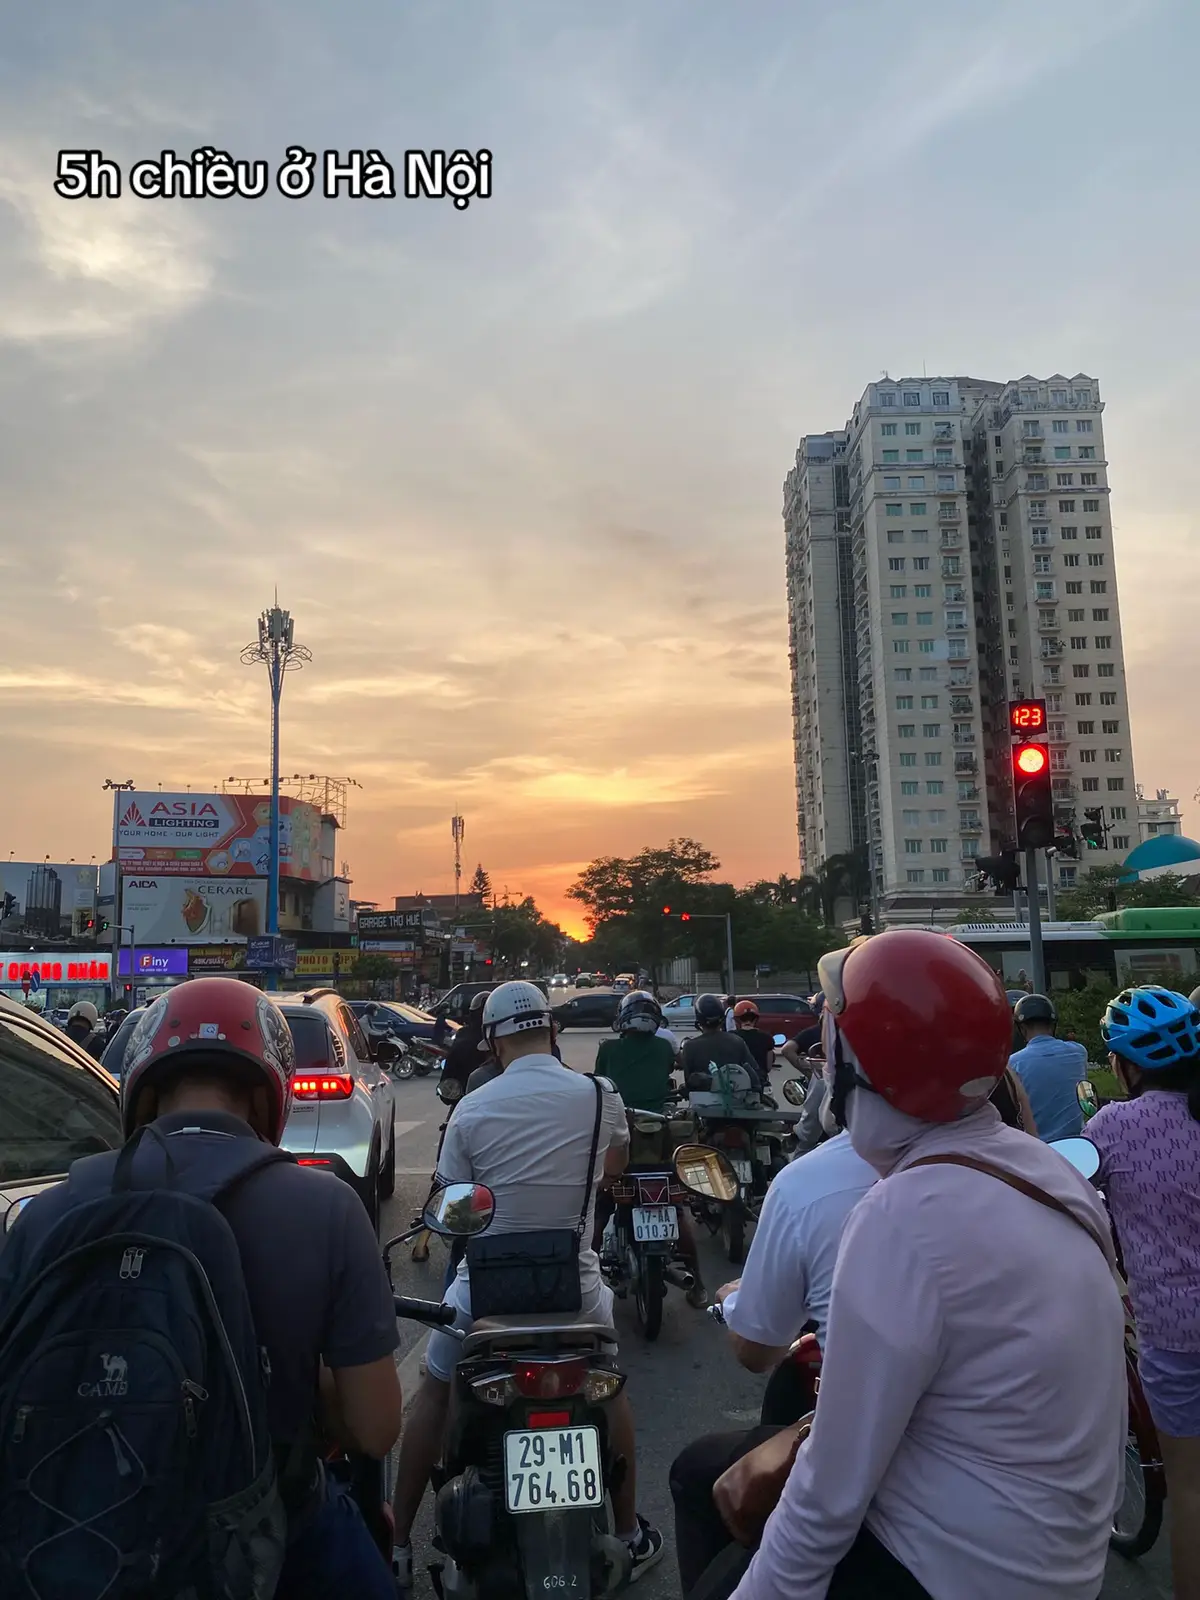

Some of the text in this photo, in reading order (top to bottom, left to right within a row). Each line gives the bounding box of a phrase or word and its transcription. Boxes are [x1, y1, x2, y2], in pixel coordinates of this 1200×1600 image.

[1014, 708, 1041, 726] 123
[150, 801, 219, 816] ASIA
[154, 819, 215, 828] LIGHTING
[119, 829, 141, 837] YOUR
[128, 880, 158, 889] AICA
[198, 885, 253, 895] CERARL
[359, 916, 388, 929] GARAGE
[143, 956, 169, 967] Finy
[296, 955, 329, 965] PHOTO
[1140, 1108, 1160, 1118] NY
[1120, 1119, 1140, 1131] NY
[1164, 1118, 1184, 1130] NY
[1145, 1127, 1167, 1139] NY
[1126, 1139, 1147, 1151] NY
[1171, 1138, 1190, 1150] NY
[1151, 1148, 1173, 1160] NY
[1132, 1160, 1152, 1172] NY
[1176, 1159, 1195, 1171] NY
[1156, 1170, 1177, 1182] NY
[1138, 1182, 1158, 1194] NY
[636, 1223, 675, 1239] 010.37
[518, 1432, 585, 1468] 29-M1
[512, 1468, 597, 1507] 764.68
